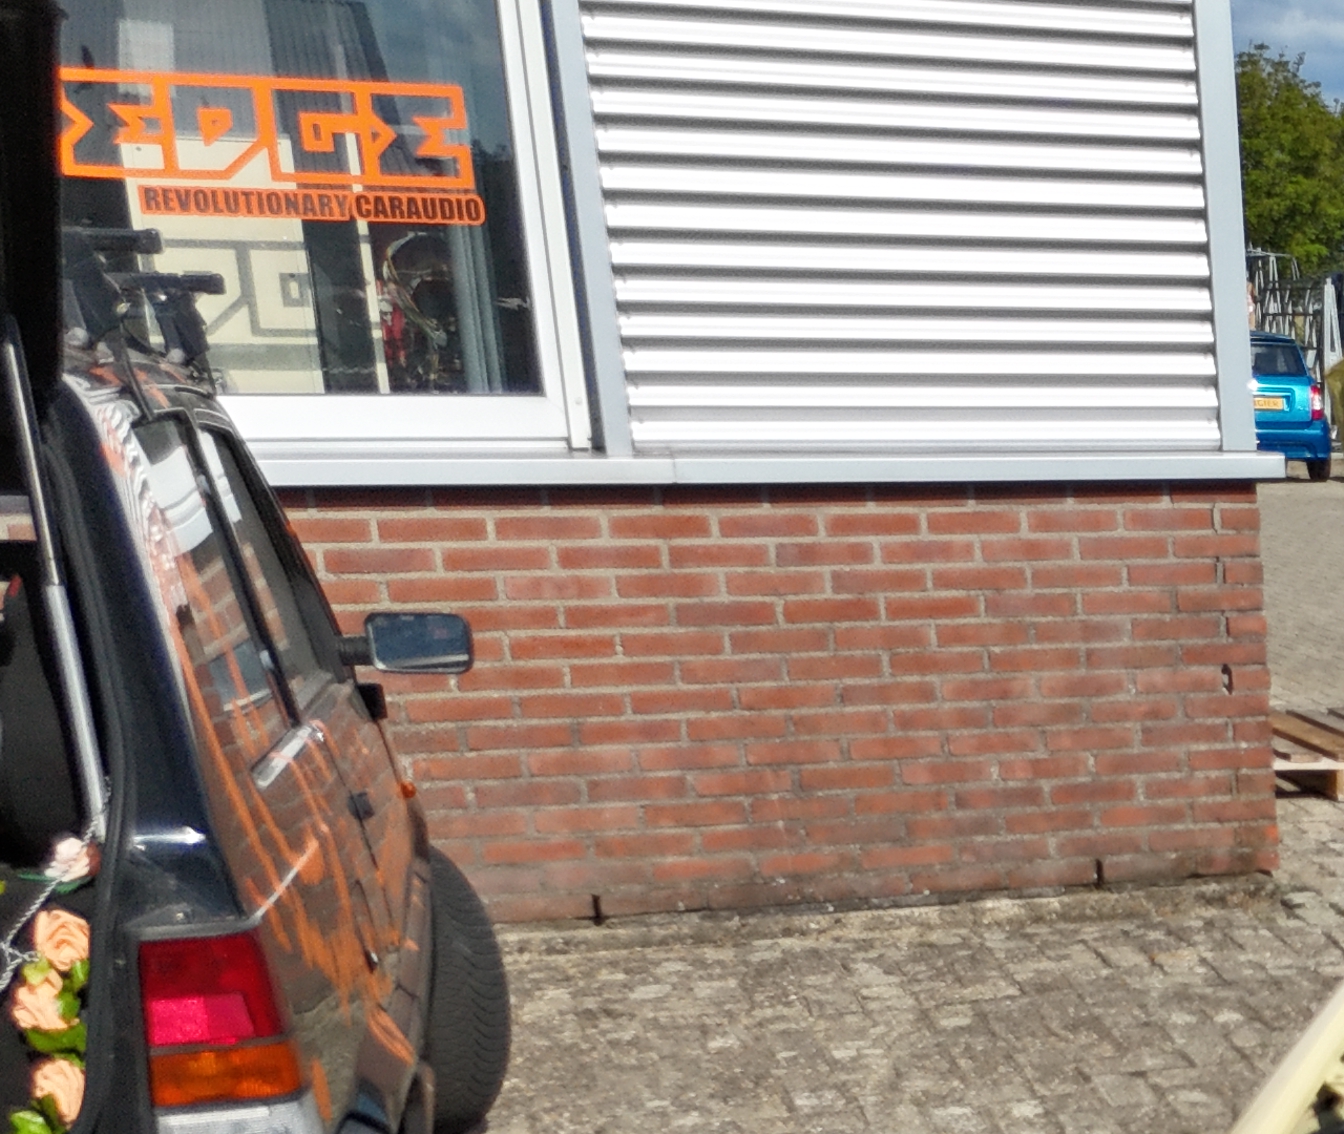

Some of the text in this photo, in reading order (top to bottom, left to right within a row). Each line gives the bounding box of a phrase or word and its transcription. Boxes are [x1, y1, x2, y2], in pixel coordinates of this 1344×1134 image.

[58, 66, 475, 189] EDGE
[144, 187, 481, 222] REVOLUTIONARY CARAUDIO
